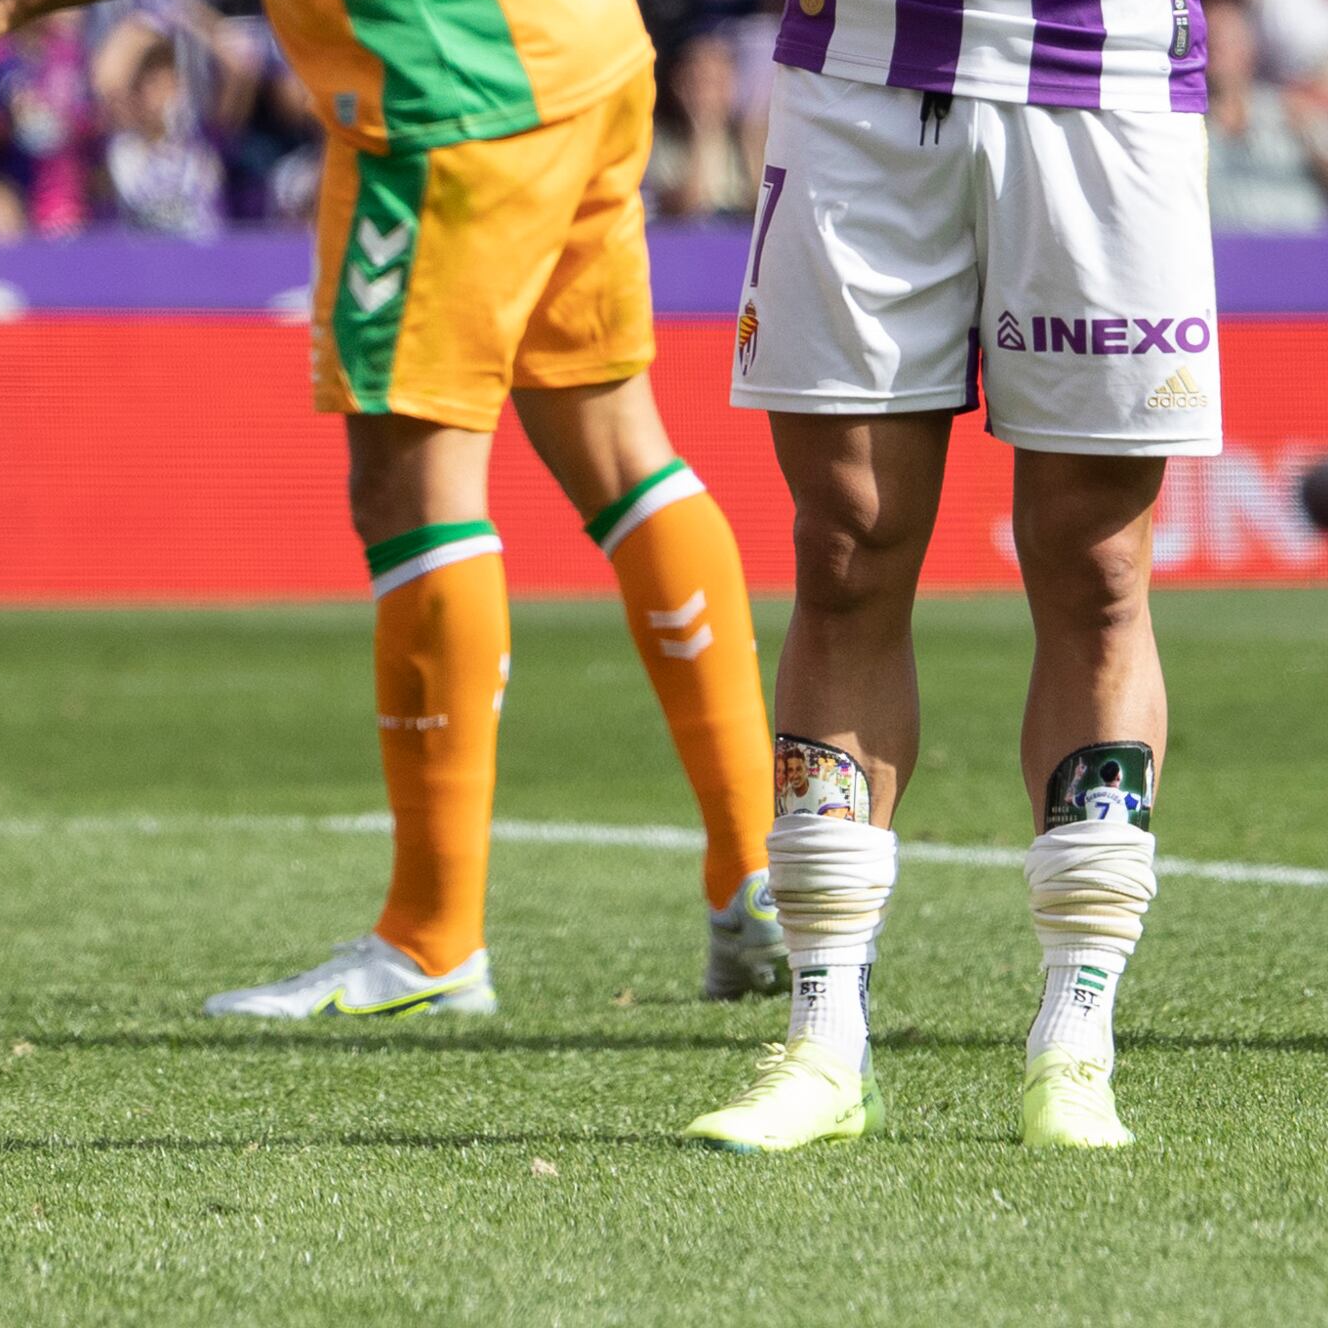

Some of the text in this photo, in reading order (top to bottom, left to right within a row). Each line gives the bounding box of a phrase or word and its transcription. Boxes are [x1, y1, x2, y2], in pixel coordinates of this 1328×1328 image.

[749, 163, 788, 288] 7
[1031, 316, 1211, 355] INEXO
[1146, 392, 1209, 409] adidas
[1094, 801, 1110, 820] 7
[1082, 1004, 1092, 1018] 7
